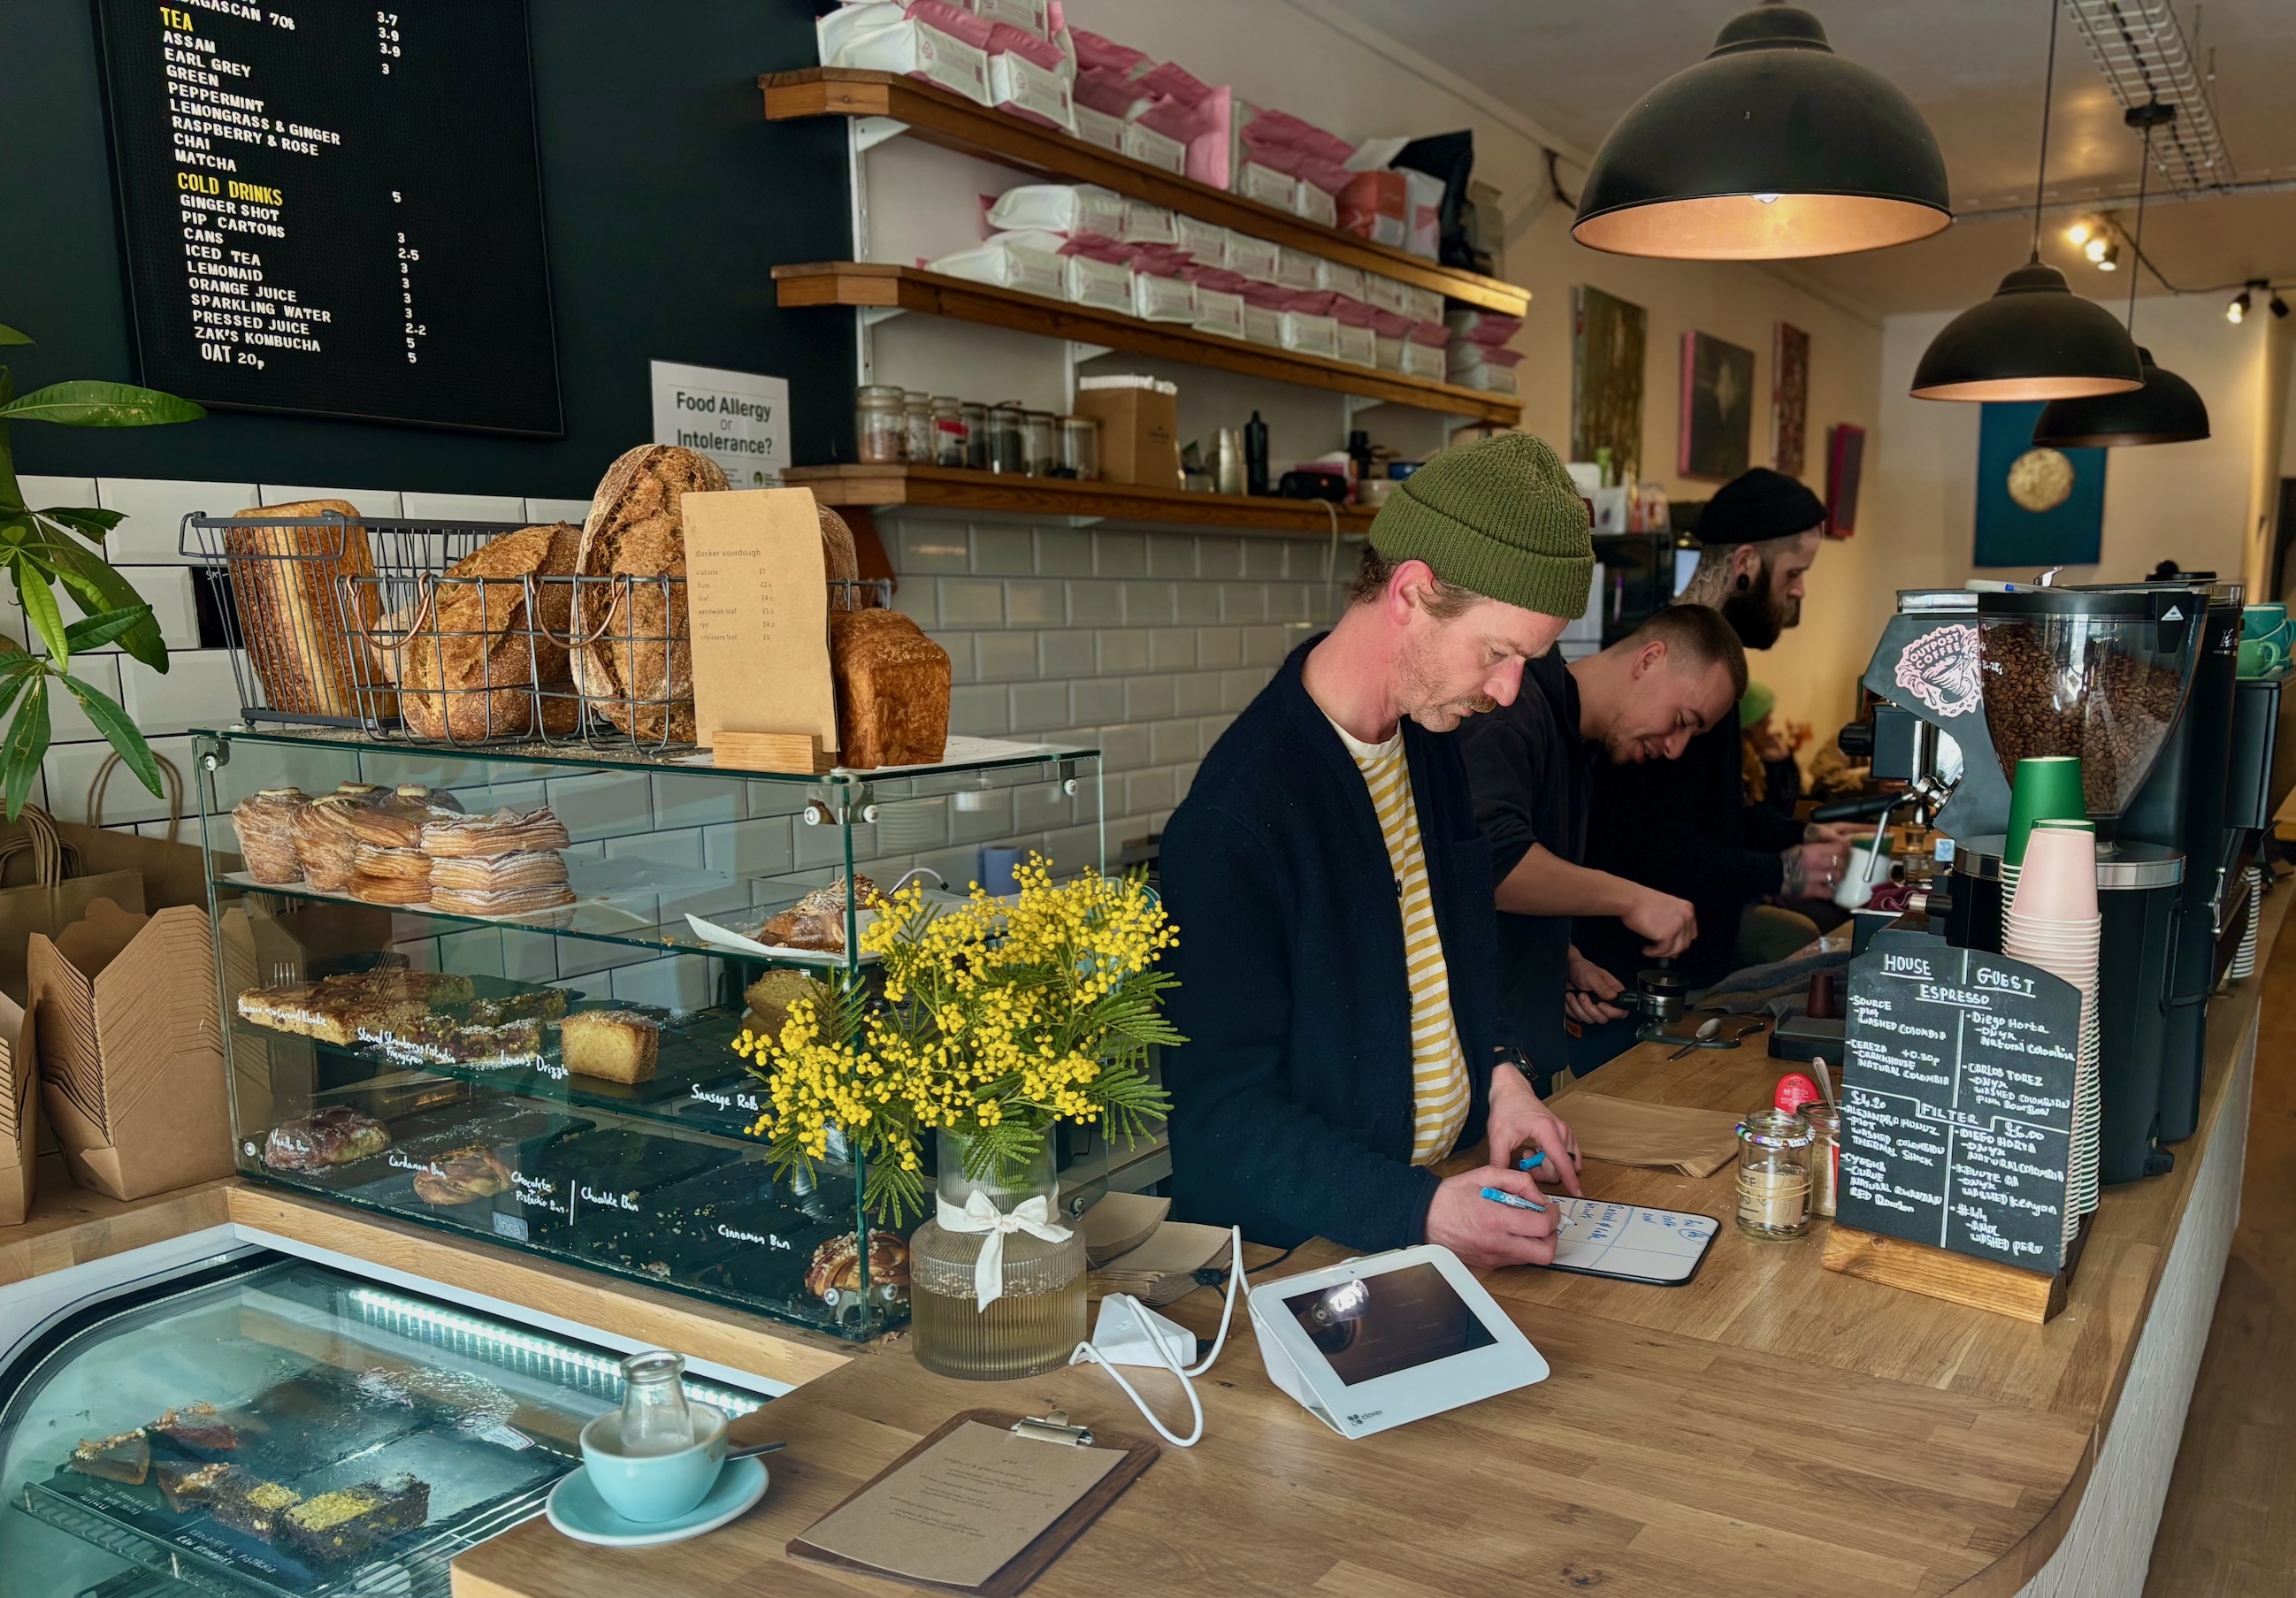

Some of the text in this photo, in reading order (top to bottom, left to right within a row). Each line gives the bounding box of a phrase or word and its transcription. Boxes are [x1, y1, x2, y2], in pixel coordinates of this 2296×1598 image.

[160, 7, 194, 32] TEA
[377, 11, 398, 27] 3.7
[164, 30, 217, 53] ASSAM
[379, 27, 400, 42] 3.9
[380, 42, 402, 57] 3.9
[165, 47, 251, 78] EARL GREY
[381, 63, 390, 75] 3
[166, 65, 219, 87] GREEN
[168, 81, 264, 113] PEPPERMINT
[170, 98, 341, 145] LEMONGRASS & GINGER
[172, 116, 319, 157] RASPBERRY & ROSE
[173, 133, 210, 150] CHAI
[175, 149, 237, 172] MATCHA
[178, 172, 283, 207] COLD DRINKS
[392, 190, 402, 203] 5
[180, 194, 279, 222] GINGER SHOT
[182, 210, 286, 238] PIP CARTONS
[184, 227, 224, 244] CANS
[397, 232, 406, 244] 3
[185, 243, 261, 266] ICED TEA
[398, 248, 420, 261] 2.5
[187, 260, 264, 282] LEMONAID
[400, 263, 409, 274] 3
[188, 277, 297, 302] ORANGE JUICE
[402, 278, 410, 289] 3
[190, 294, 332, 323] SPARKLING WATER
[403, 293, 412, 304] 3
[193, 310, 310, 335] PRESSED JUICE
[405, 307, 413, 319] 3
[195, 325, 321, 353] ZAK'S KOMBUCHA
[405, 322, 427, 336] 2.2
[406, 337, 416, 349] 5
[201, 342, 264, 371] OAT 20p
[408, 352, 417, 364] 5
[677, 391, 771, 423] Food Allergy
[720, 419, 732, 431] or
[677, 429, 772, 455] Intolerance?
[722, 548, 762, 558] sourdough
[1910, 631, 1960, 662] OUTPOST
[1916, 641, 1961, 669] COFFEE
[1884, 953, 2035, 993] HOUSE GUEST
[1919, 983, 1990, 1005] ESPRESSO
[1857, 1015, 1897, 1031] WASHED
[2008, 1019, 2050, 1034] Horta
[425, 1044, 456, 1064] Pistachio
[1980, 1036, 2076, 1061] Natural Colombia
[536, 1054, 570, 1080] Drizzle
[1857, 1059, 1949, 1086] NATURAL COLOMBIA
[691, 1083, 731, 1112] Sausage
[1974, 1086, 2016, 1101] WASHED
[1920, 1103, 1978, 1125] FILTER
[271, 1128, 310, 1152] Vanilla Bun
[1902, 1150, 1934, 1167] SHOCK
[431, 1162, 447, 1179] Bun
[510, 1171, 553, 1192] Chocolate
[1849, 1176, 1892, 1193] NATURAL
[516, 1190, 565, 1213] Pistachio Bun
[581, 1186, 639, 1212] Chocolate Bun
[1962, 1187, 2008, 1205] WASHED
[718, 1224, 791, 1250] Cinnamon Bun
[1970, 1233, 2009, 1251] WASHED
[1361, 1409, 1383, 1420] clover
